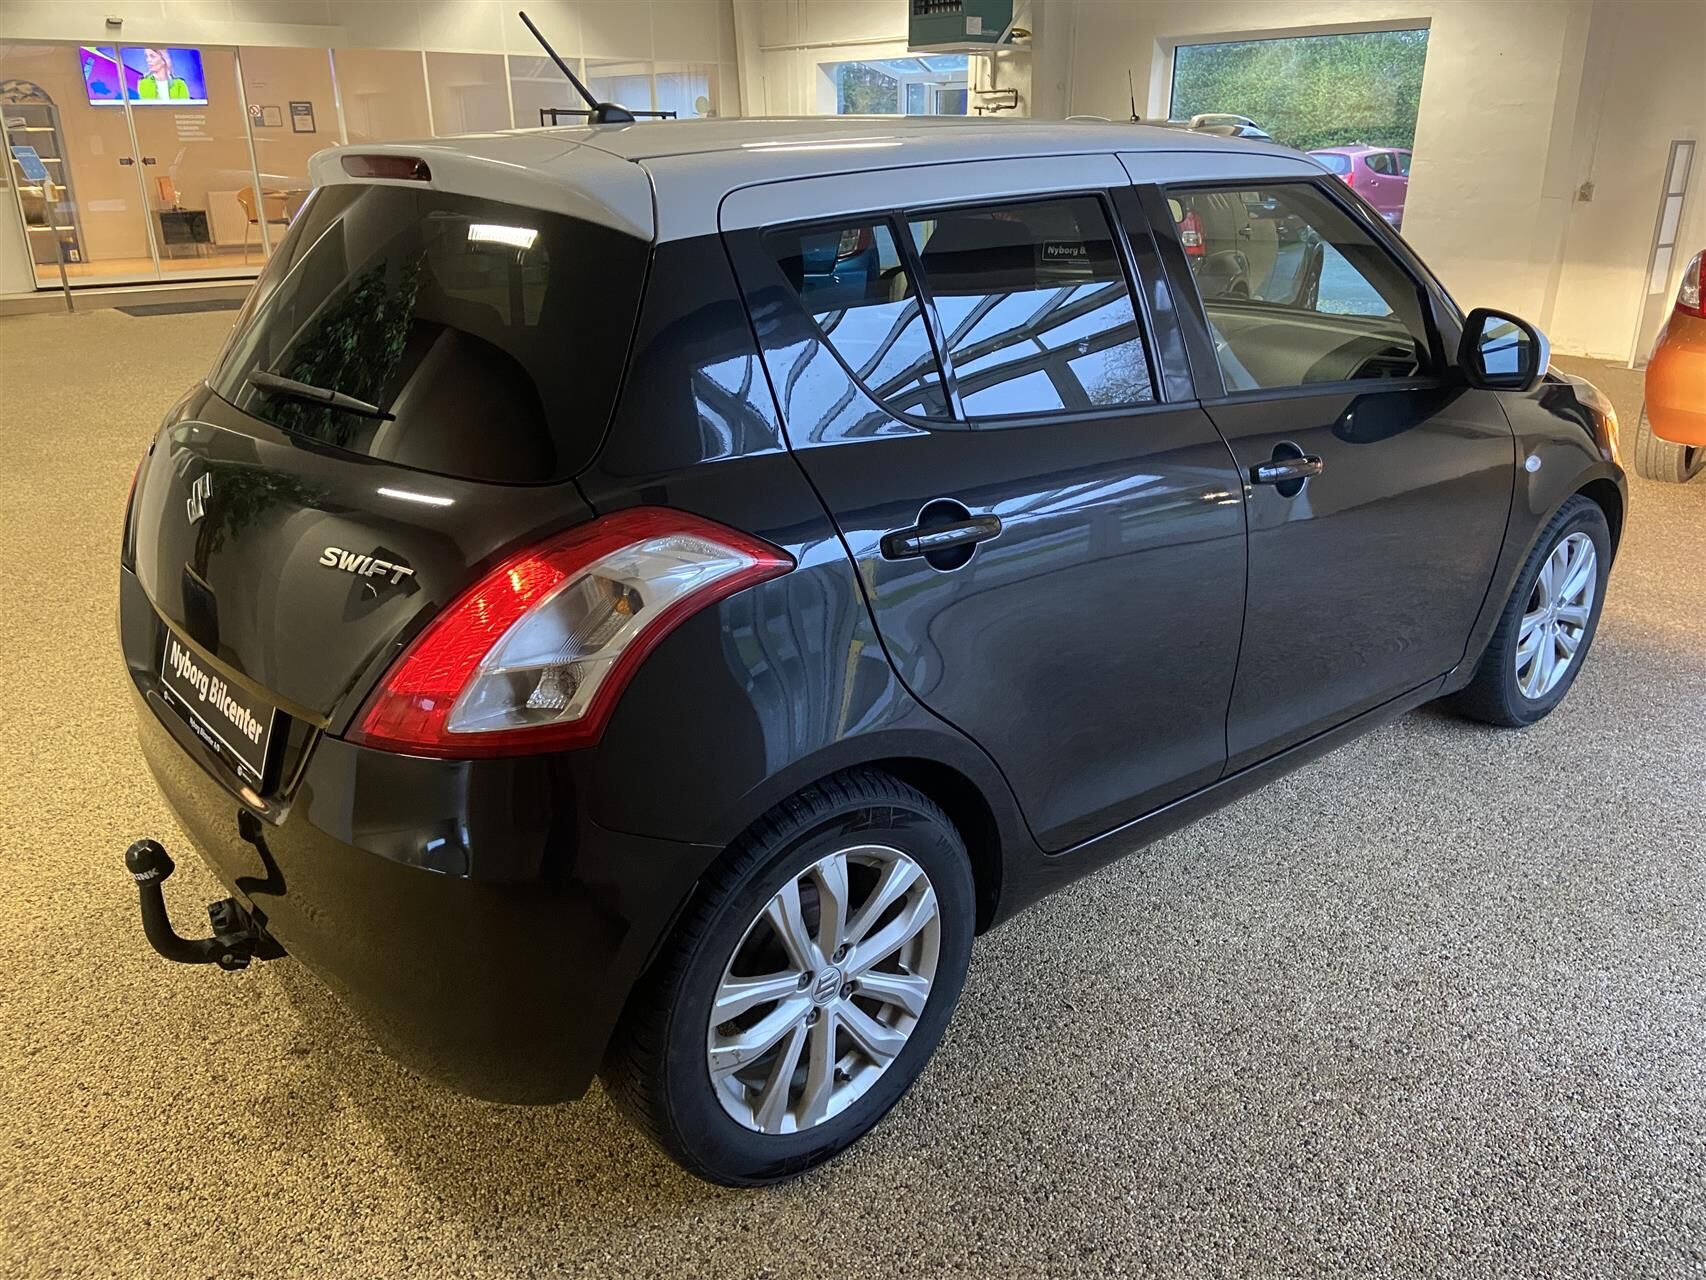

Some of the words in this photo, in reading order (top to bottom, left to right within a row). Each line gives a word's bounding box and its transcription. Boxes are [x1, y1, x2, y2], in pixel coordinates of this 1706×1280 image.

[1047, 245, 1079, 256] Nyborg
[319, 546, 415, 585] SWIFT
[170, 640, 209, 702] Nyborg
[208, 675, 263, 745] Bilcenter
